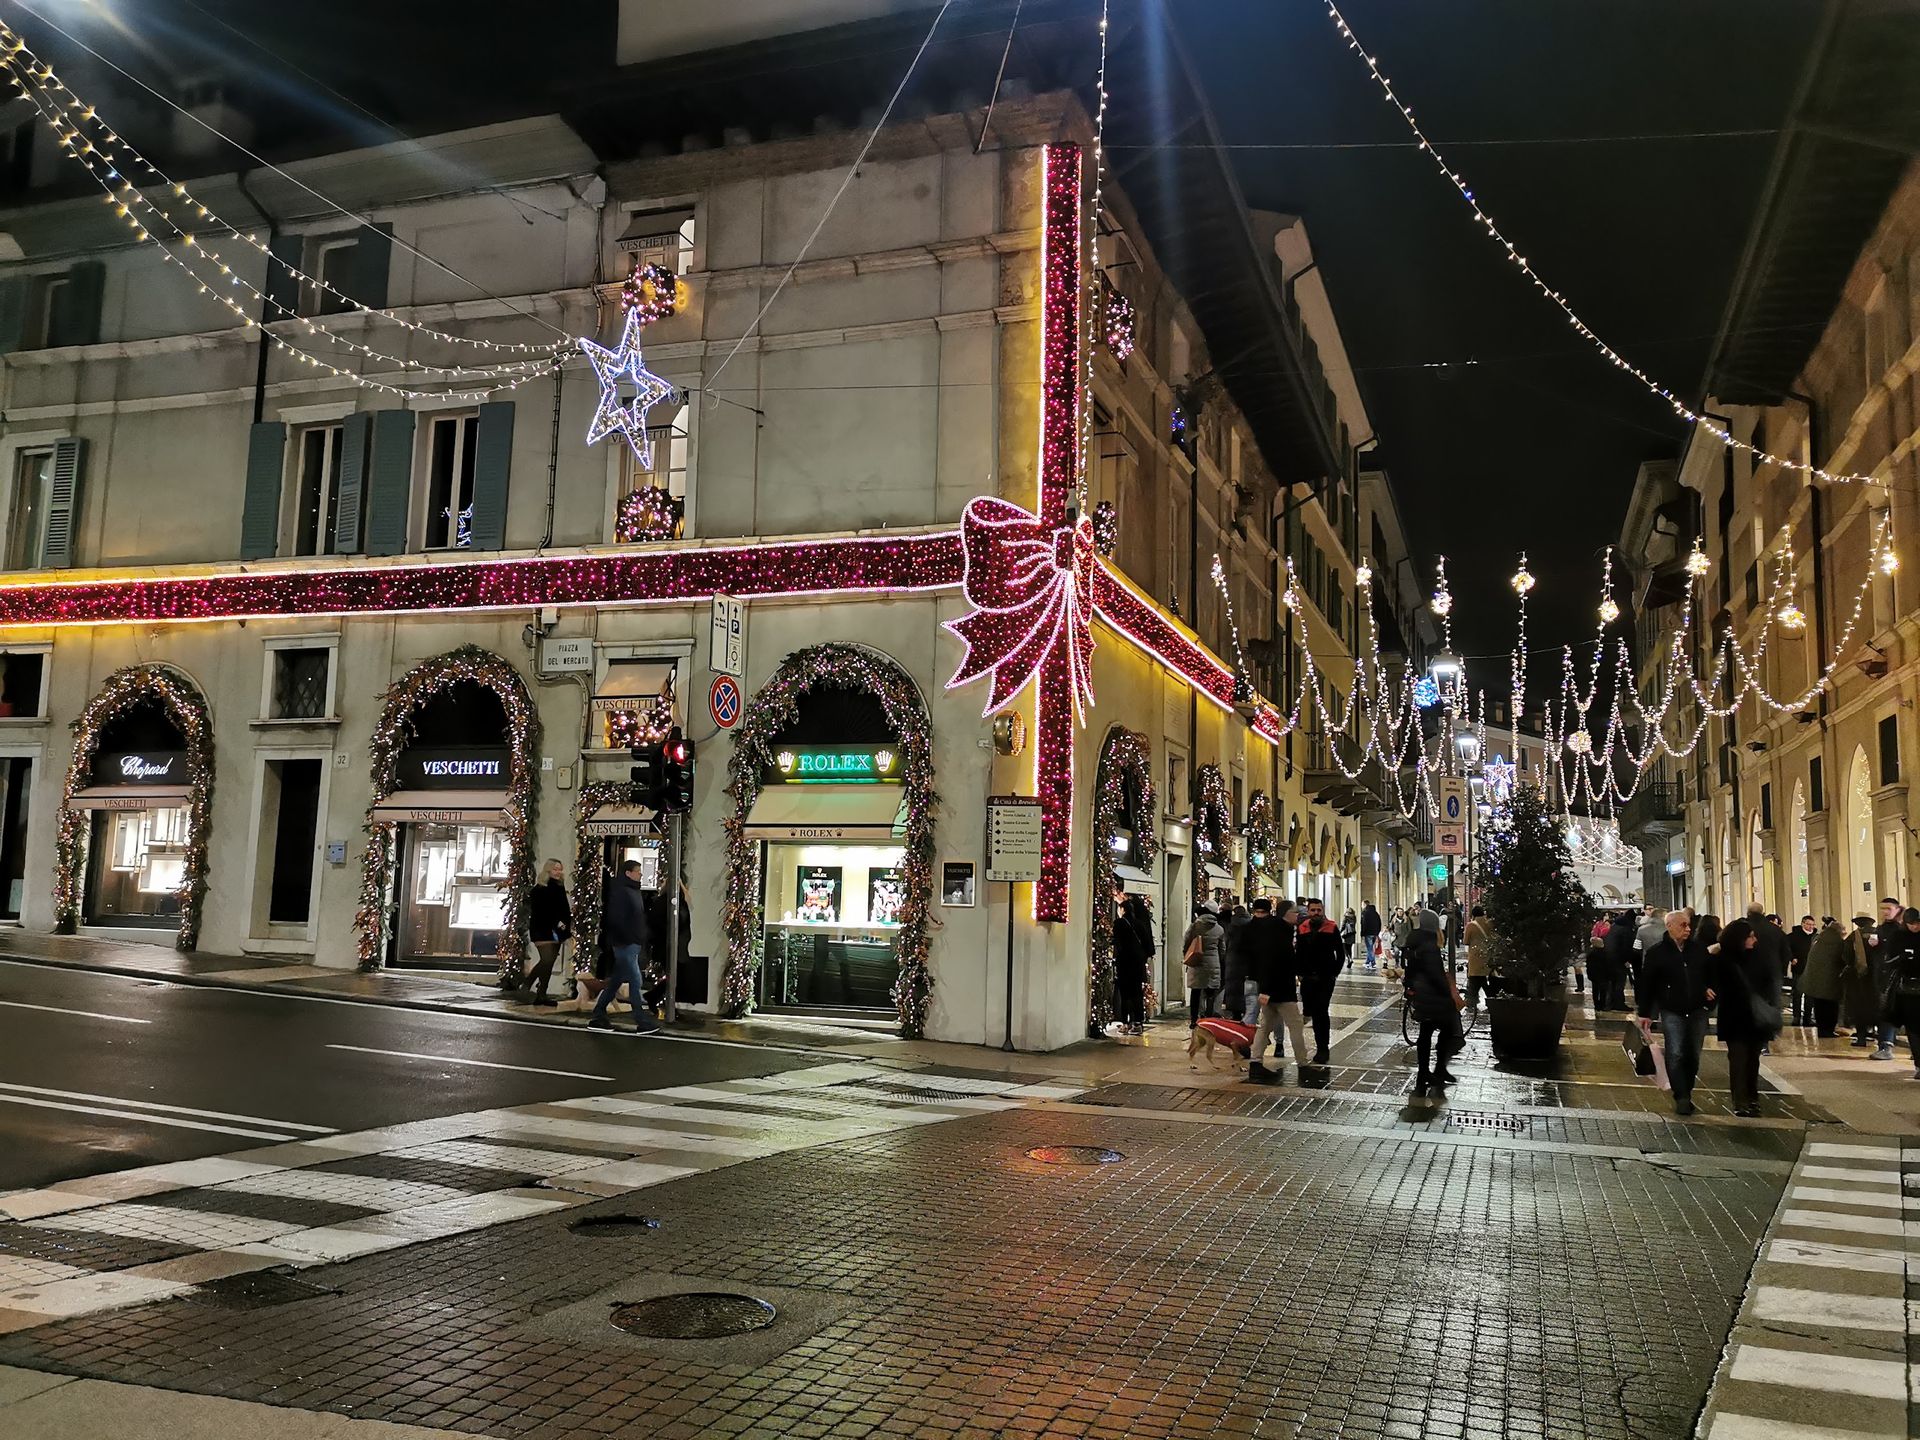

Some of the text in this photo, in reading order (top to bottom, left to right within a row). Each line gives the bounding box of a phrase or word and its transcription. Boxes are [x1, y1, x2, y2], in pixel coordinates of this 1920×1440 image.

[620, 235, 674, 251] VESCHETTI
[559, 644, 578, 652] PIAZZA
[548, 657, 588, 665] DEL MERCATO
[595, 700, 653, 710] VESCHETTI
[337, 755, 346, 764] 32
[797, 754, 870, 771] ROLEX
[120, 755, 173, 779] Chopard
[422, 760, 499, 775] VESCHETTI
[104, 799, 147, 809] VESCHETTI
[410, 811, 463, 821] VESCHETTI
[589, 824, 647, 834] VESCHETTI
[800, 829, 833, 837] ROLEX
